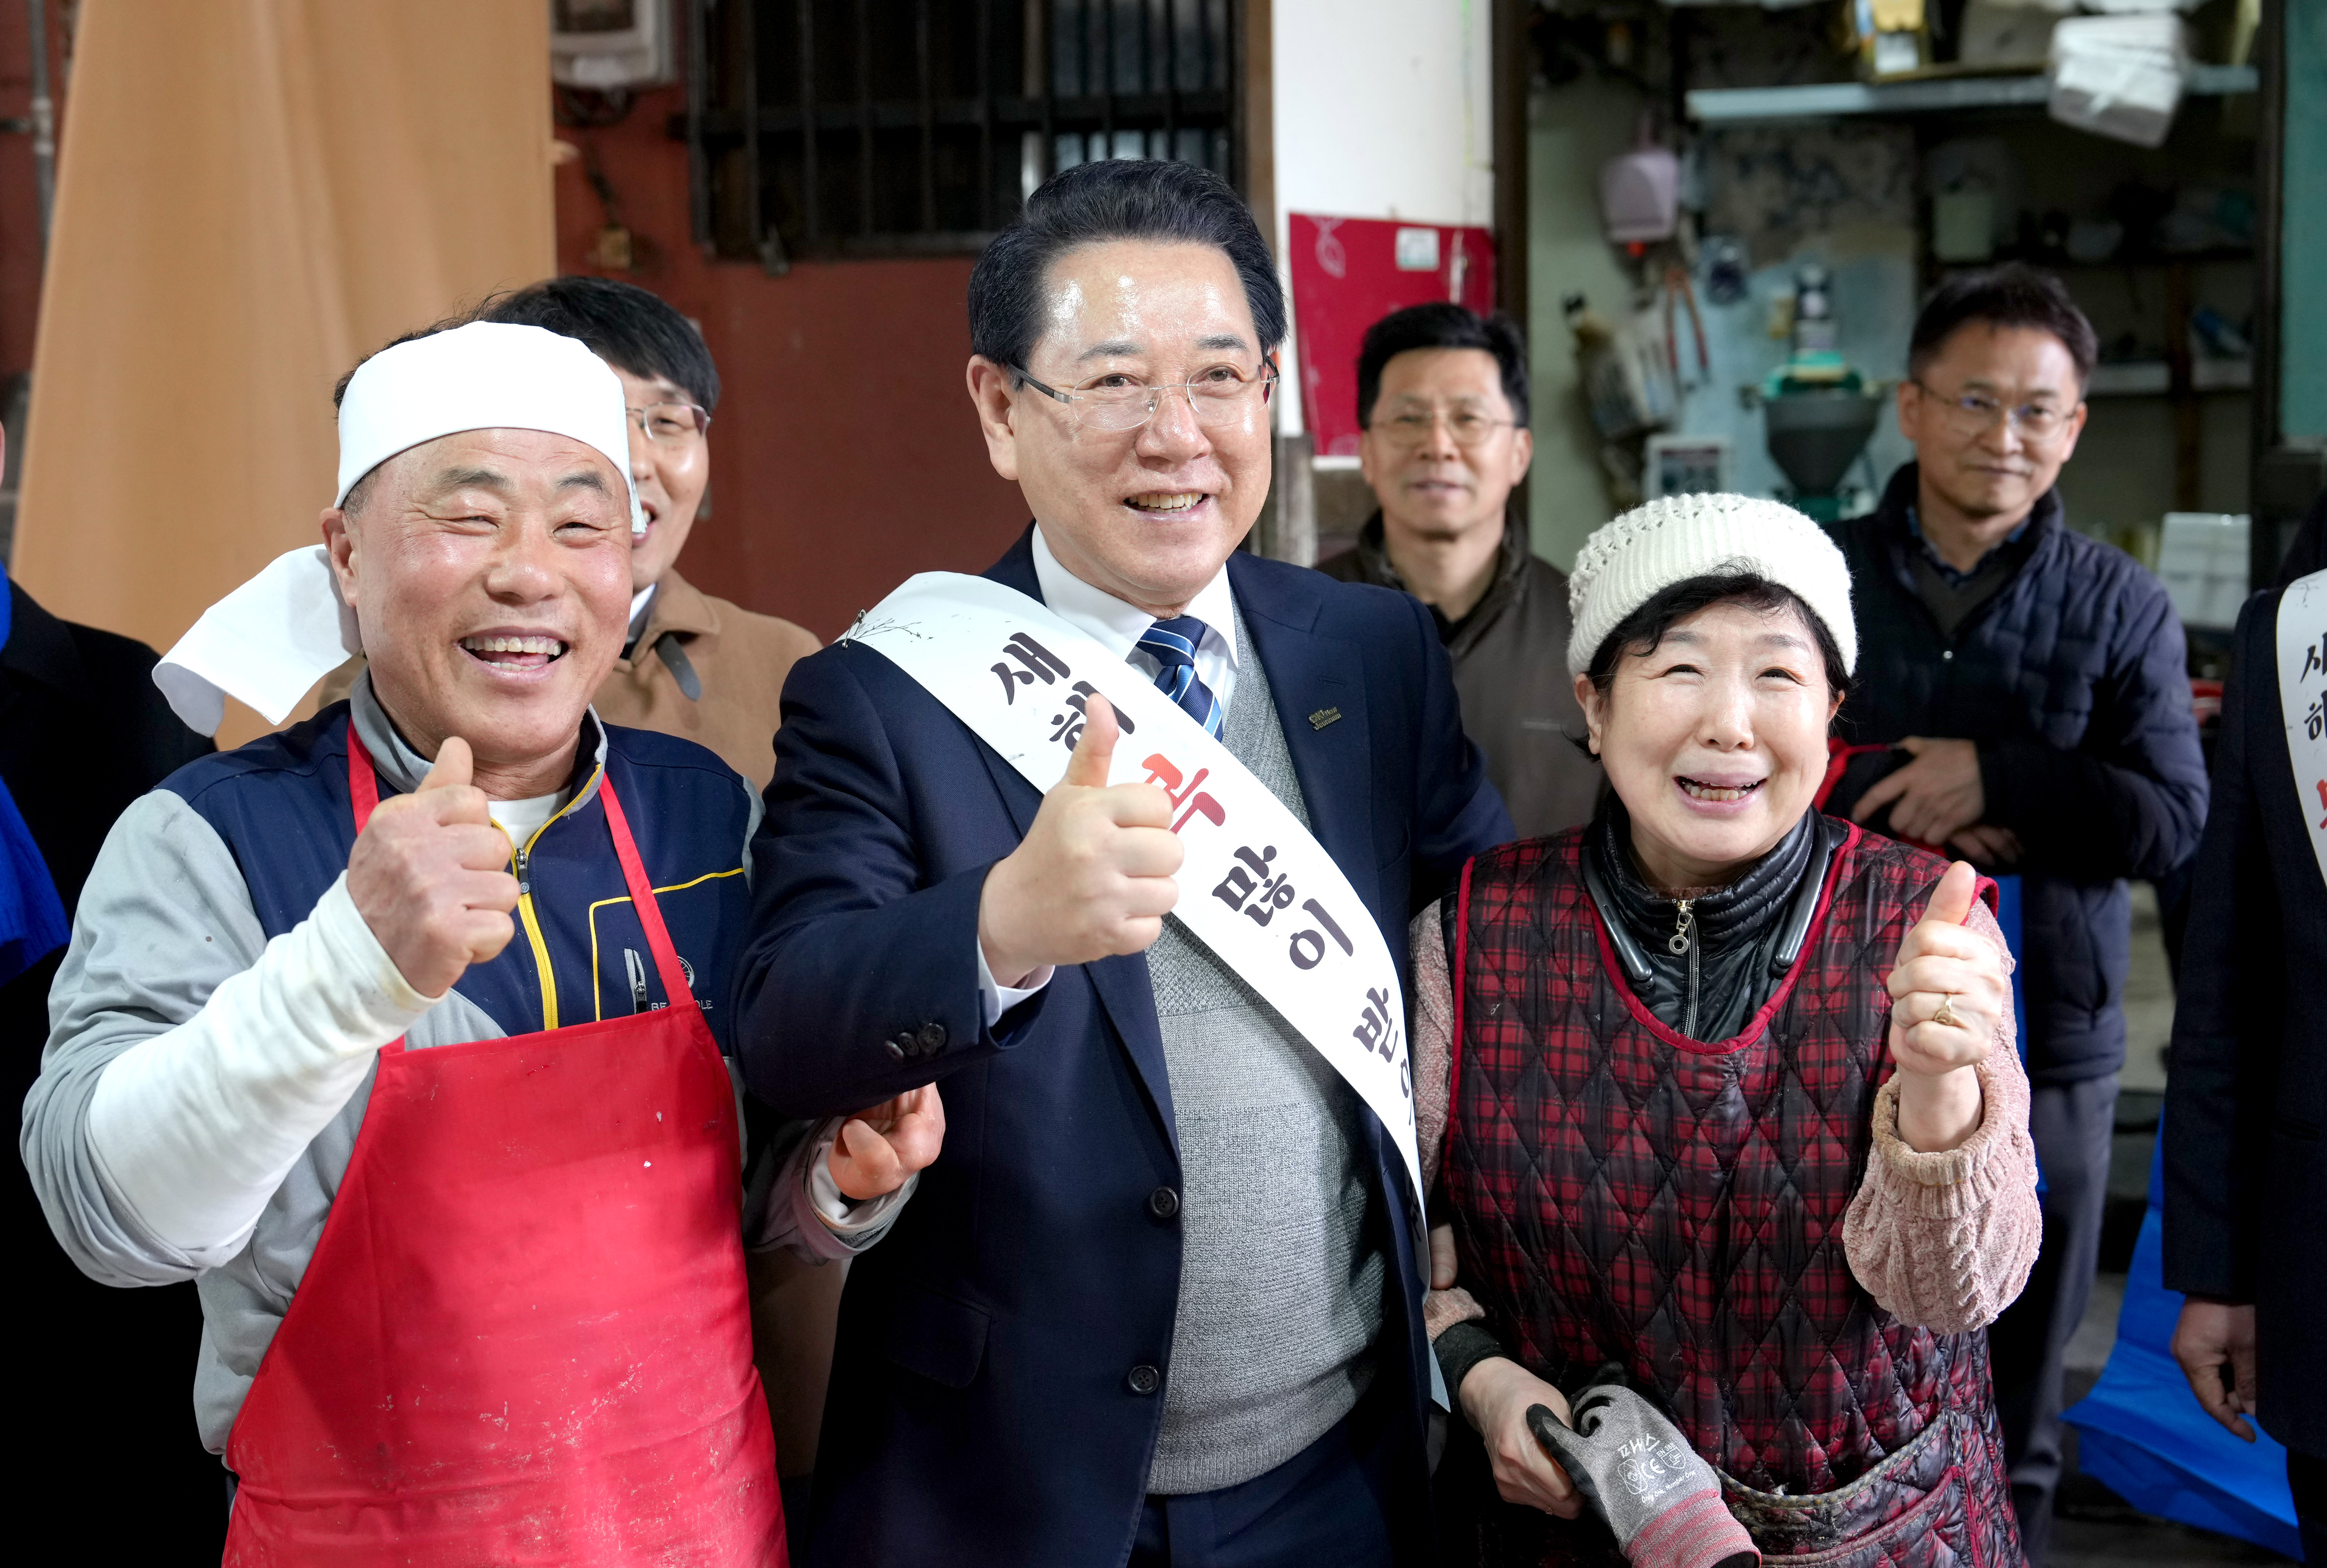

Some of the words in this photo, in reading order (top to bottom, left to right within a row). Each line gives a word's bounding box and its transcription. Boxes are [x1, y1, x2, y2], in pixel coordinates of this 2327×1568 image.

[1313, 713, 1341, 731] Jeonnam
[1212, 845, 1353, 970] 많이
[1664, 1442, 1675, 1452] 388
[1641, 1458, 1666, 1479] CE
[1642, 1494, 1654, 1503] Only
[1665, 1476, 1685, 1490] Number
